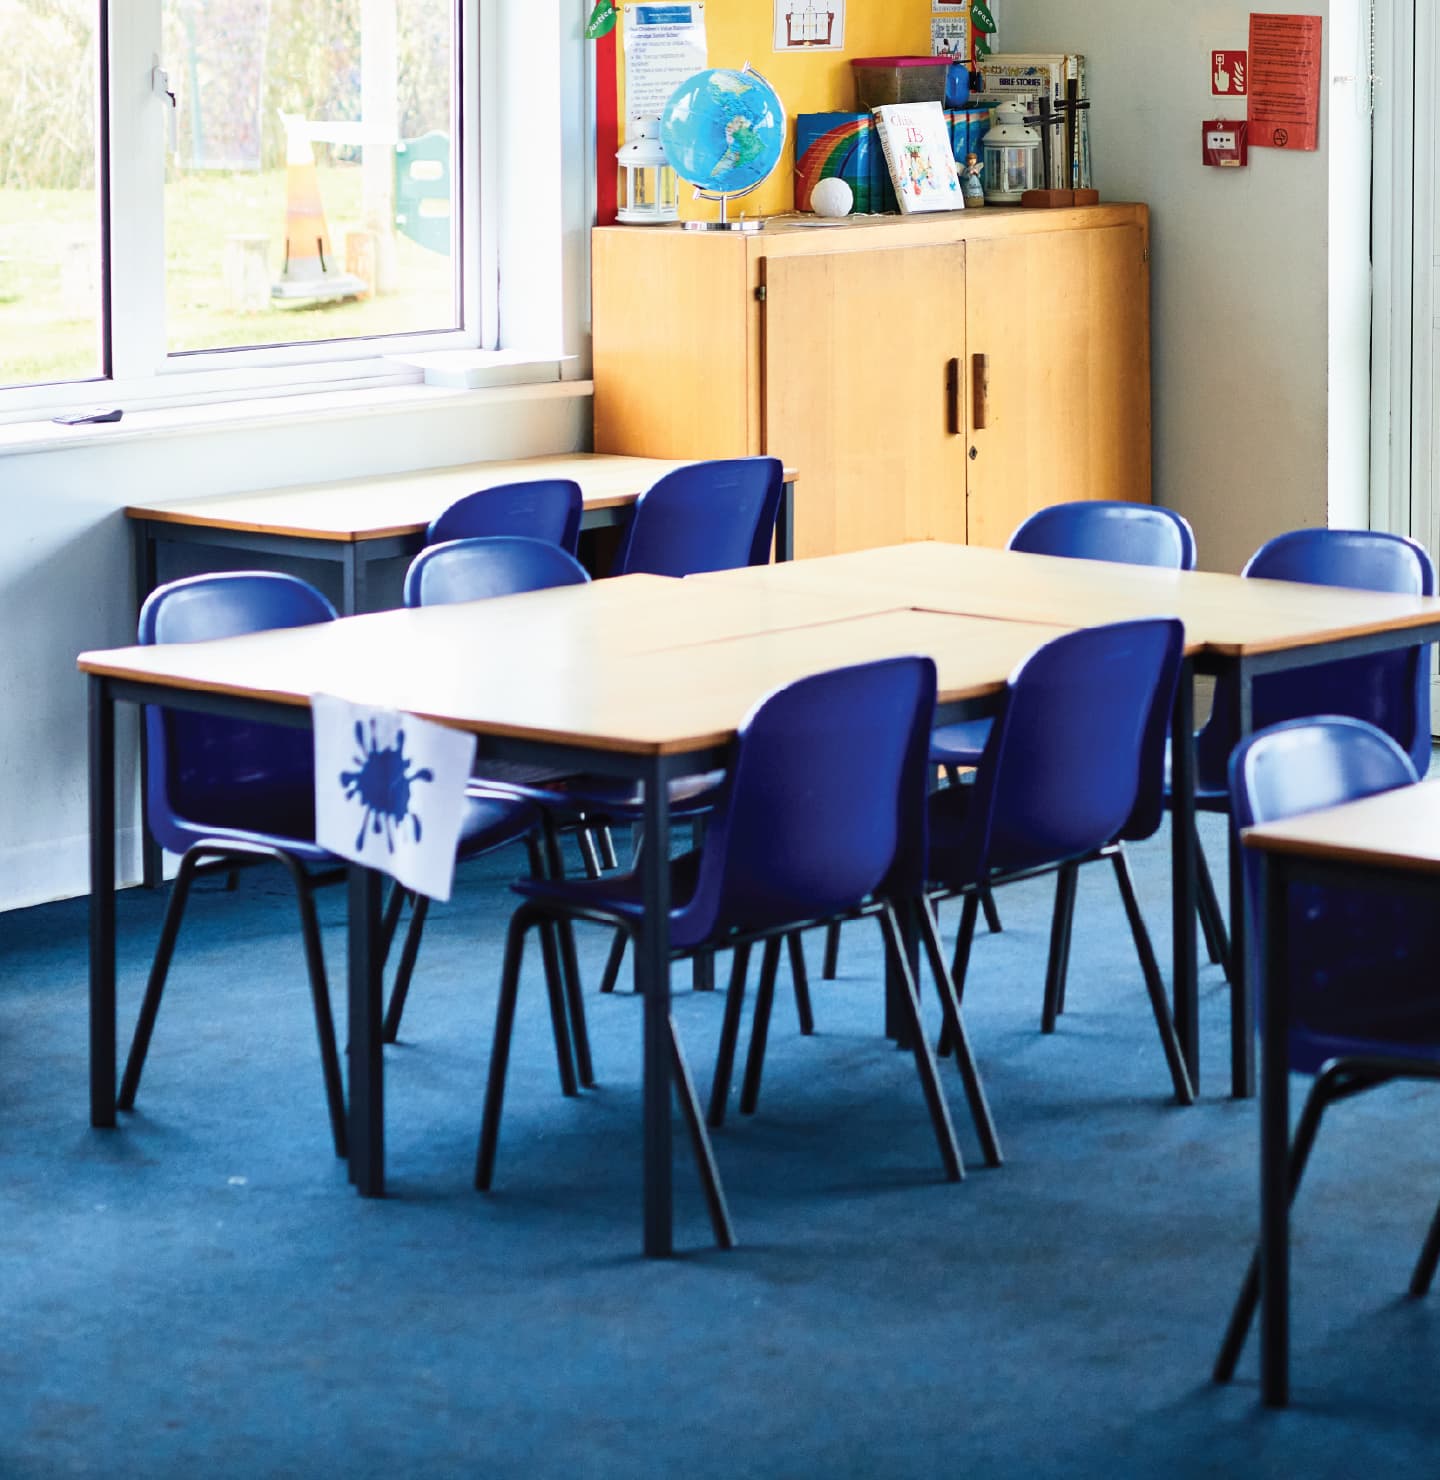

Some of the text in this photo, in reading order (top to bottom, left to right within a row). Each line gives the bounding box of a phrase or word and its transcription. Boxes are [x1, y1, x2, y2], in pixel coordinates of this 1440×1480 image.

[589, 7, 613, 37] justice
[972, 5, 993, 28] peace
[999, 78, 1041, 86] BIBLE STORIES
